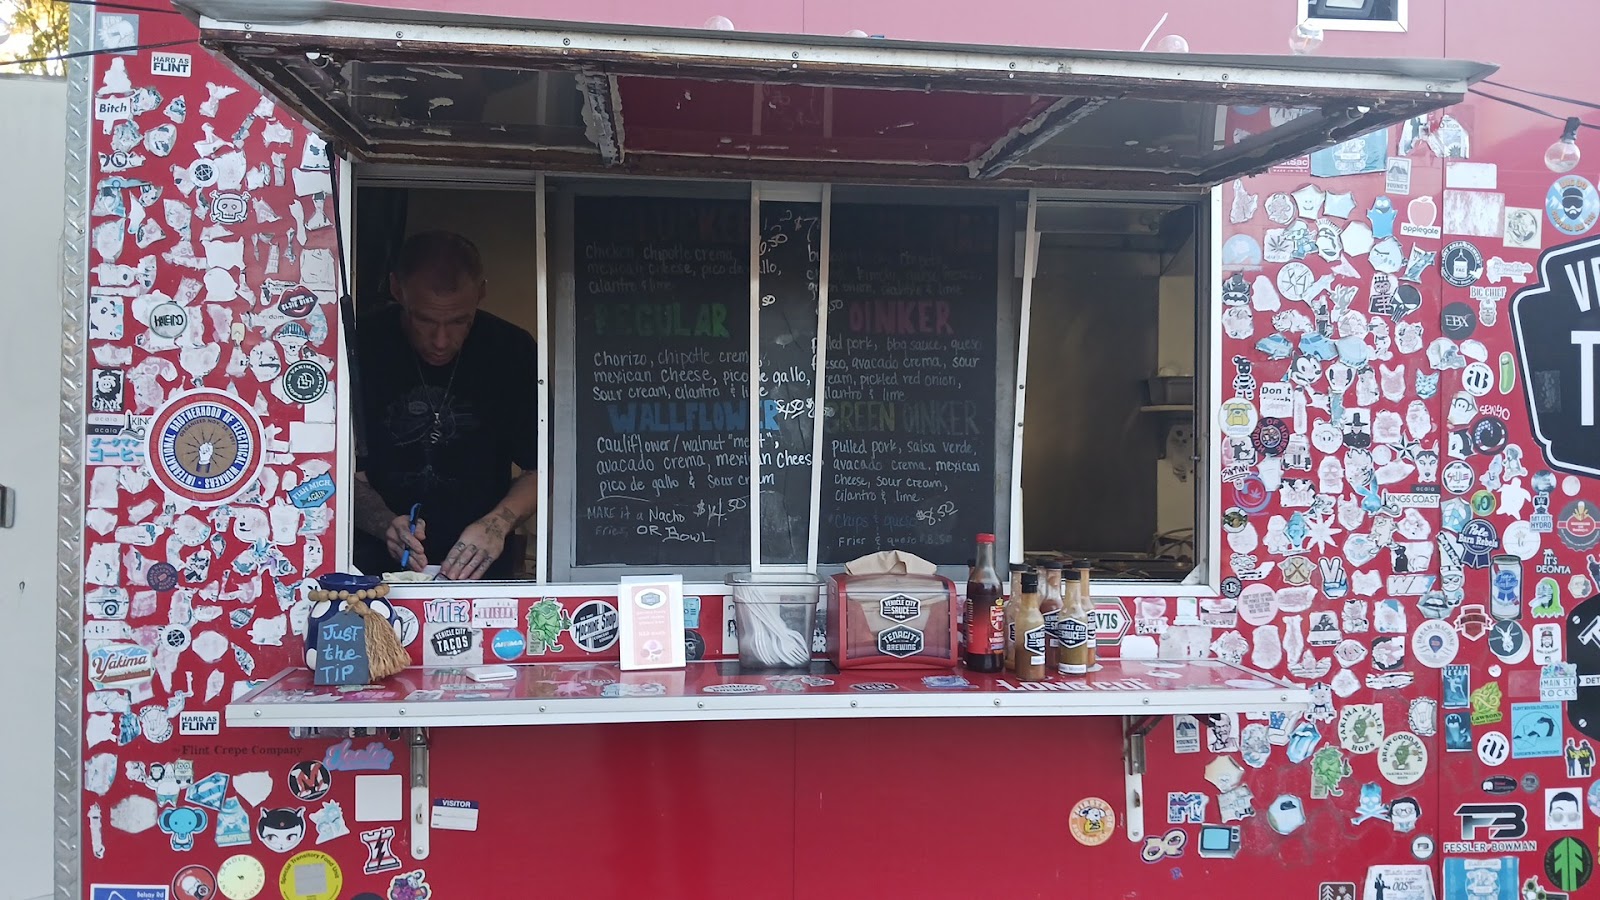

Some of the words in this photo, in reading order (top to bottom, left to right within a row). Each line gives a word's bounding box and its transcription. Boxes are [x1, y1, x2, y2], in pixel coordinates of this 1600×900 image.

[153, 56, 177, 65] HARD
[179, 57, 190, 65] AS
[153, 63, 189, 73] FLINT
[99, 102, 128, 114] Bitch
[1403, 225, 1439, 235] applegate
[701, 265, 725, 279] pico
[1471, 287, 1483, 297] BIG
[1485, 287, 1505, 297] CHIEF
[1445, 314, 1472, 328] EBX
[847, 338, 877, 355] pork,
[910, 339, 947, 352] sauce,
[658, 347, 713, 368] chipotle
[852, 354, 899, 369] avacado
[903, 356, 947, 370] crema,
[594, 367, 652, 385] mexican
[773, 366, 811, 386] gallo,
[860, 370, 899, 389] pickled
[903, 370, 921, 385] red
[925, 371, 963, 389] onion,
[628, 385, 671, 399] cream,
[675, 384, 720, 400] cilantro
[883, 387, 905, 401] lime
[92, 400, 122, 412] OINK
[170, 406, 222, 433] BROTHERHOOD
[222, 412, 234, 424] OF
[682, 433, 725, 452] walnut
[1253, 421, 1265, 453] HOUSE
[1266, 418, 1279, 426] OF
[231, 423, 248, 466] ELECTRICAL
[871, 439, 902, 458] pork,
[943, 441, 977, 455] verde,
[163, 433, 196, 486] INTERNATIONAL
[597, 457, 655, 475] avacado
[664, 452, 711, 472] crema,
[833, 460, 883, 472] avacado
[936, 460, 981, 474] mexican
[204, 466, 239, 489] WORKERS
[309, 479, 332, 490] MICH
[906, 477, 949, 492] cream,
[599, 478, 626, 498] pico
[631, 475, 646, 492] de
[652, 474, 680, 497] gallo
[1387, 495, 1412, 504] KINGS
[1413, 495, 1440, 504] COAST
[649, 507, 686, 523] Nacho
[637, 525, 662, 537] OR
[1469, 524, 1489, 538] Pole
[1530, 521, 1552, 529] HYDRO
[887, 534, 918, 549] queso
[1458, 533, 1475, 544] Barn
[1476, 536, 1499, 548] Rebels
[1545, 556, 1558, 565] IT'S
[1536, 565, 1571, 574] DEONTA
[425, 601, 468, 623] WTF?
[891, 606, 909, 614] SAUCE
[601, 613, 617, 631] SHOP
[435, 629, 455, 640] VEHICLE
[455, 627, 468, 636] CITY
[882, 630, 921, 643] TENACITY
[437, 635, 469, 653] TACOS
[886, 643, 917, 651] BREWING
[322, 644, 361, 661] the
[91, 652, 148, 681] Yakima
[996, 679, 1093, 691] LONG
[1543, 679, 1560, 687] MAIN
[1541, 689, 1576, 697] ROCKS
[182, 722, 217, 731] FLINT
[1340, 707, 1358, 742] YAKIMA
[1361, 705, 1383, 736] VALLEY
[182, 745, 209, 755] Flint
[214, 745, 248, 757] Crepe
[251, 745, 302, 758] Company
[1351, 742, 1376, 752] HOPS
[1382, 740, 1393, 763] BREW
[1392, 734, 1414, 744] GOOD
[442, 799, 472, 808] VISITOR
[320, 854, 334, 867] Food
